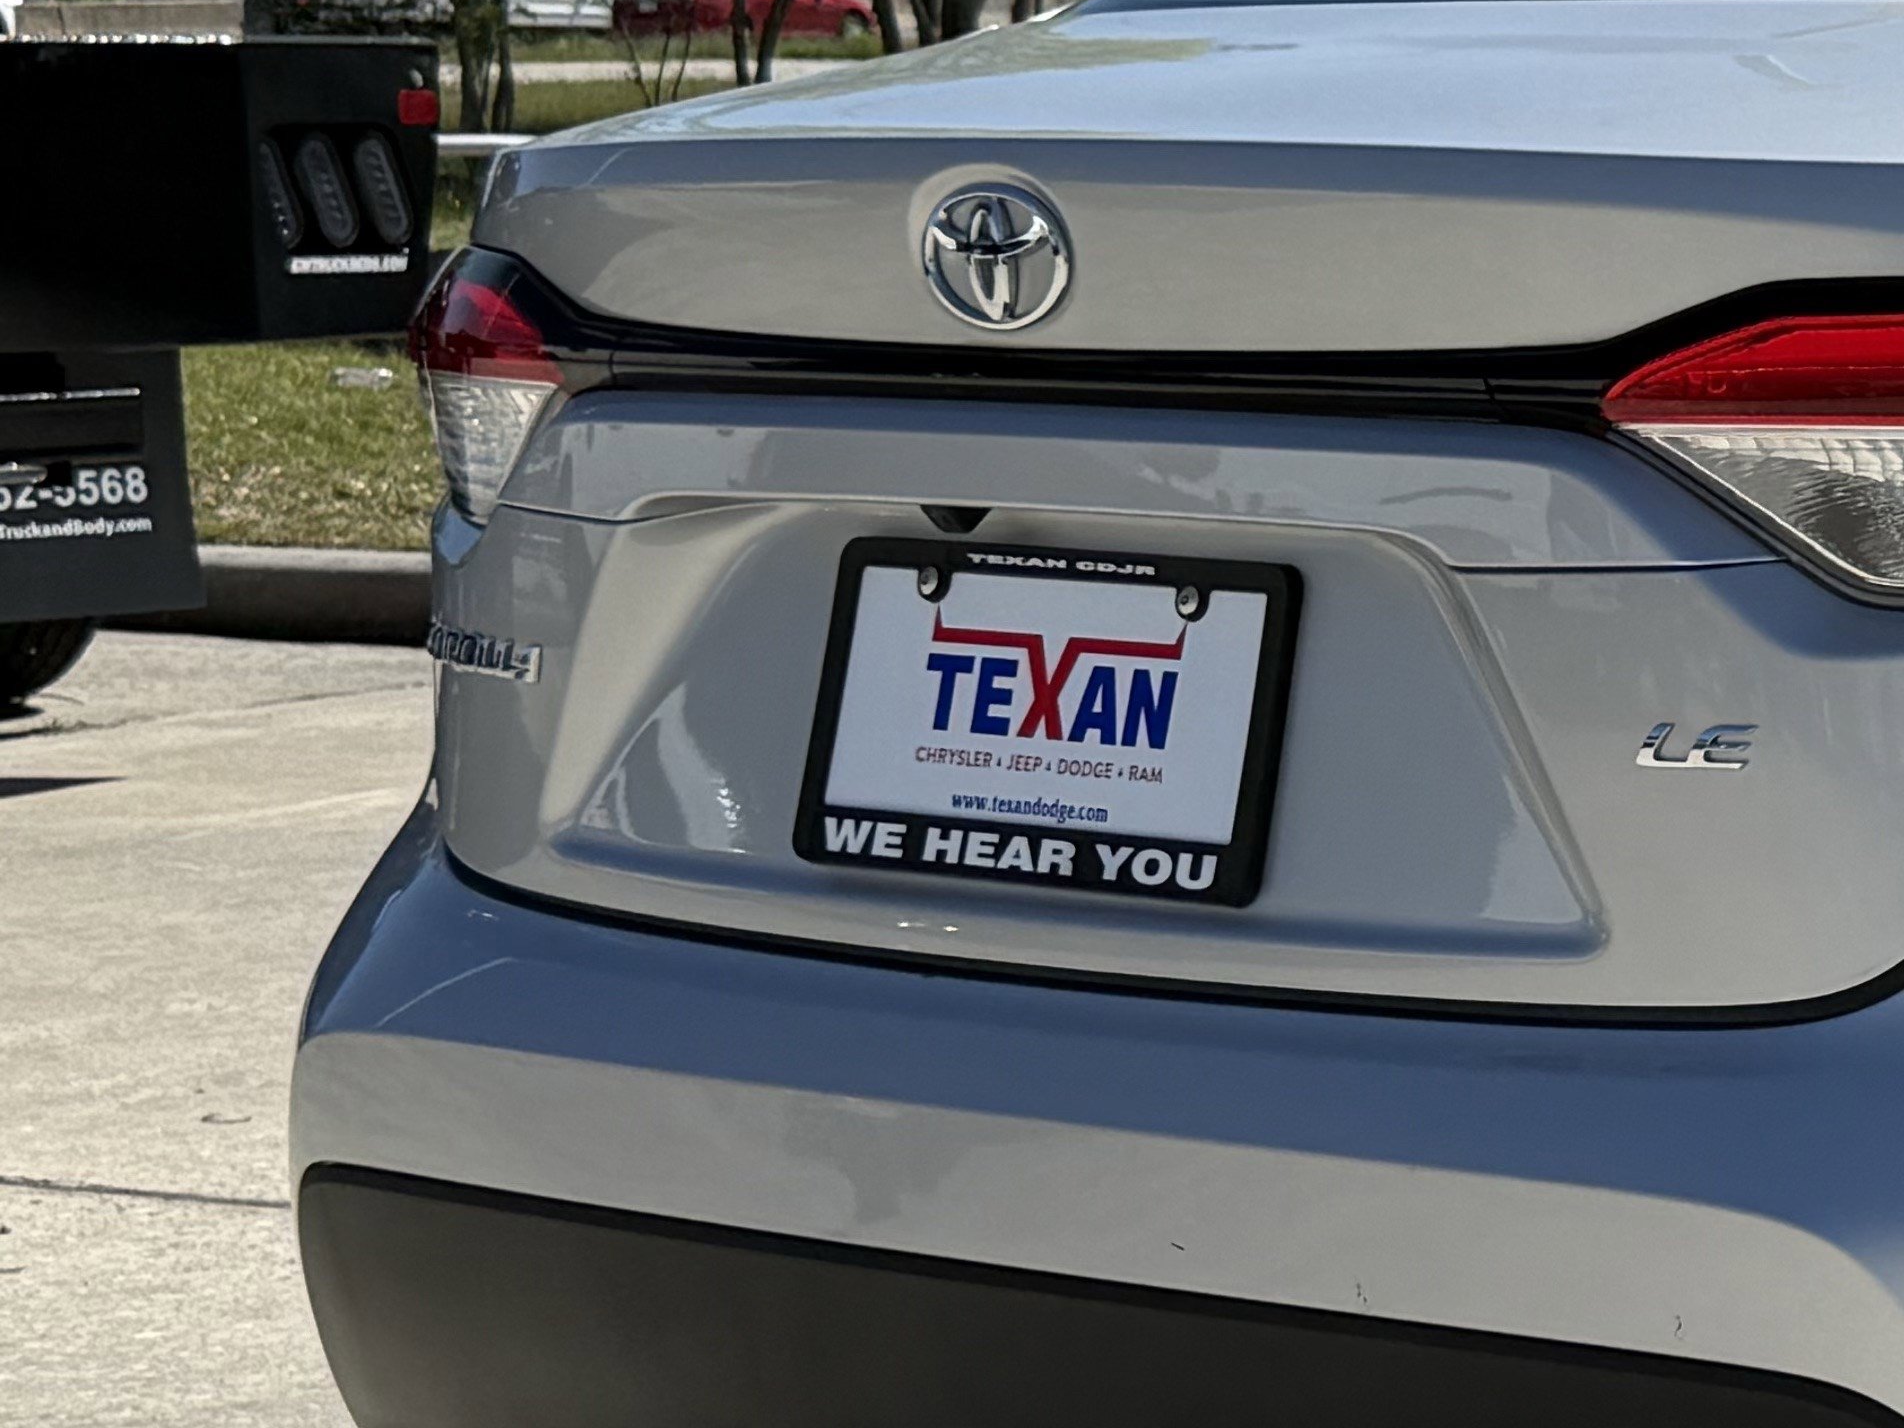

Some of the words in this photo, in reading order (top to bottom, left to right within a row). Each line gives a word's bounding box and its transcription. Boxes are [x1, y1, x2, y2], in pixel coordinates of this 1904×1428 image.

[966, 553, 1067, 569] TEXAN
[1075, 560, 1156, 576] CDJR
[926, 605, 1187, 750] TEXAN
[915, 746, 992, 769] CHRYSLER
[1006, 754, 1043, 772] JEEP
[1057, 759, 1113, 779] DODGE
[1128, 766, 1163, 784] RAM
[1636, 723, 1759, 770] LE
[951, 793, 1109, 823] www.texandodge.com
[823, 816, 906, 859] WE
[923, 826, 1076, 876] HEAR
[1095, 843, 1218, 891] YOU
